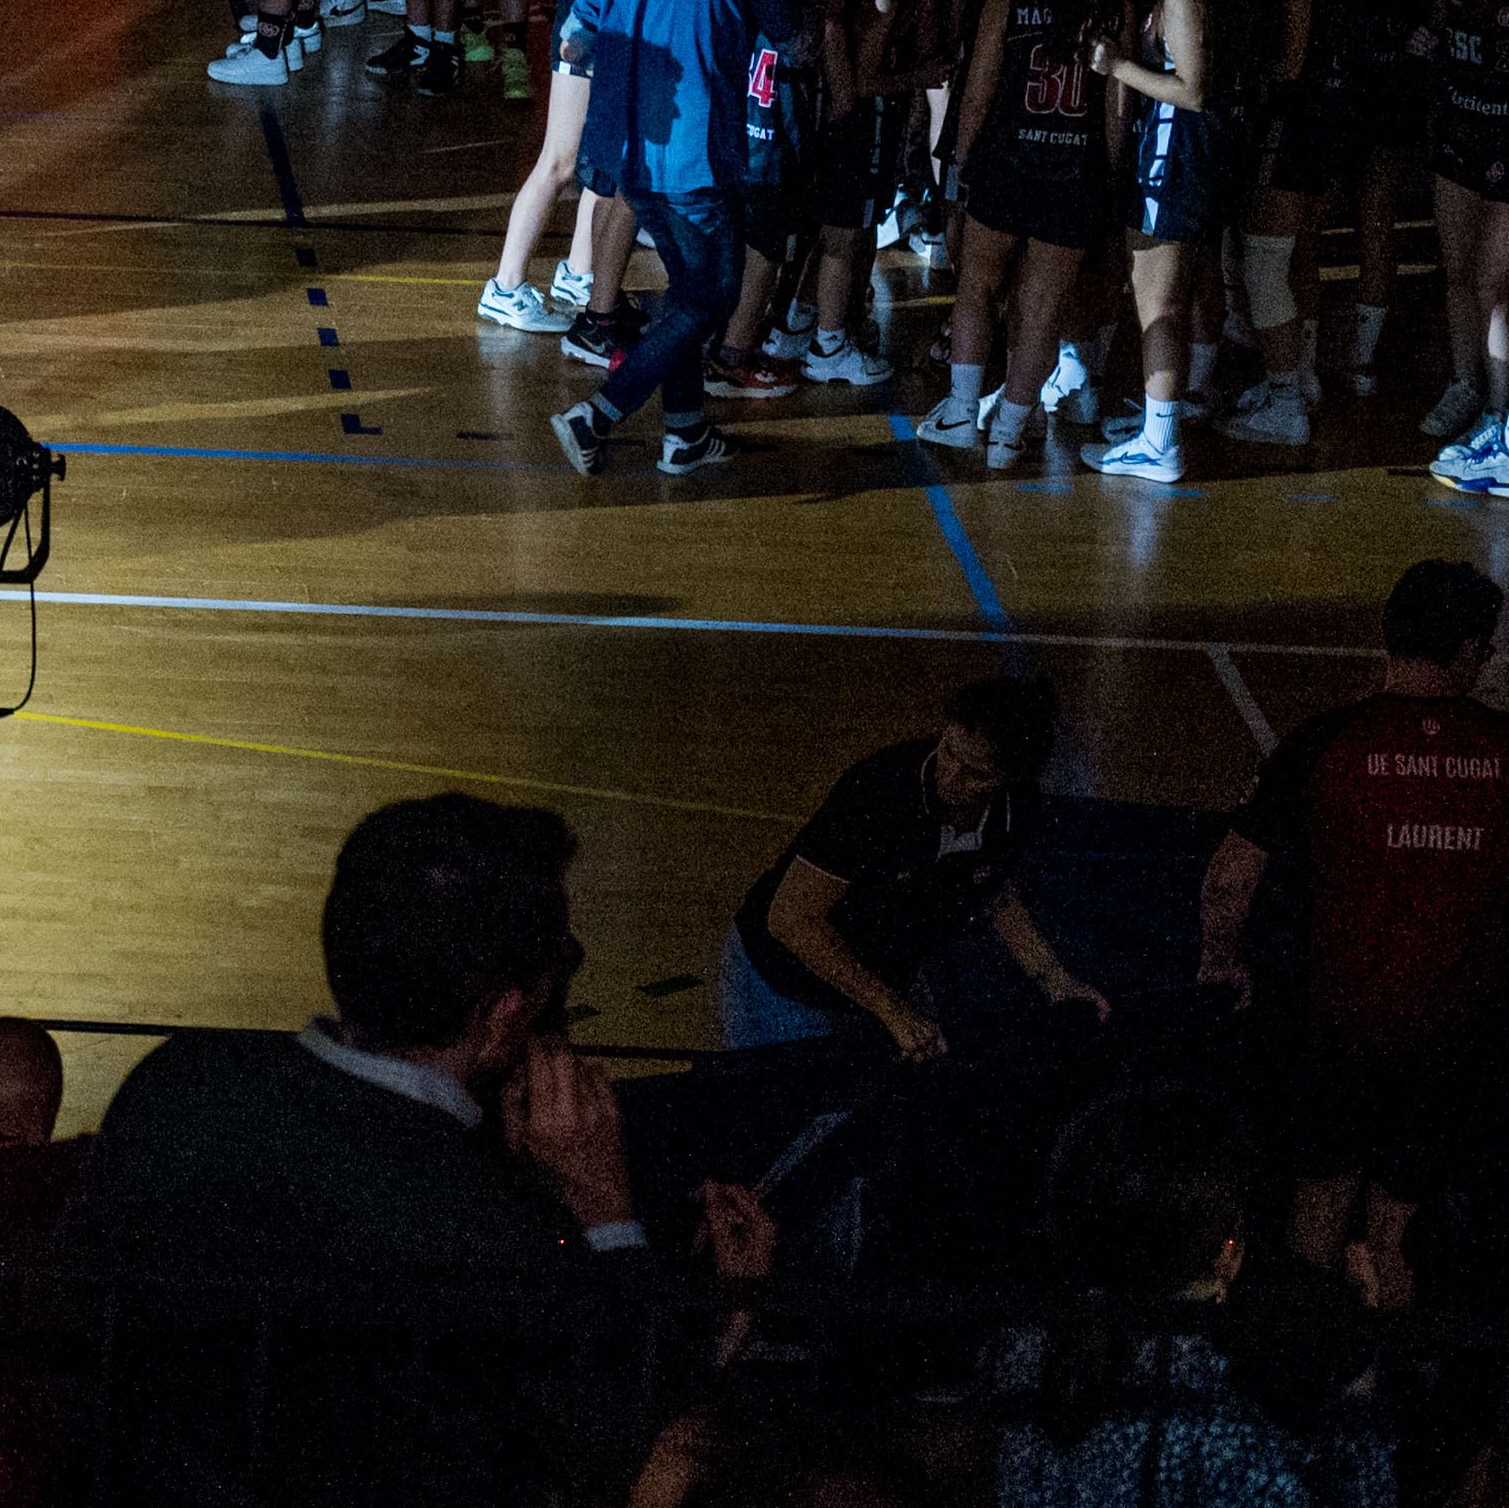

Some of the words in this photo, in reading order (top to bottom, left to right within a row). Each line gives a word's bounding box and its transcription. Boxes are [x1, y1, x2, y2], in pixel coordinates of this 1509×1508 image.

[1367, 753, 1390, 777] UE
[1394, 753, 1439, 778] SANT
[1445, 756, 1501, 780] CUGAT
[1386, 823, 1485, 851] LAURENT
